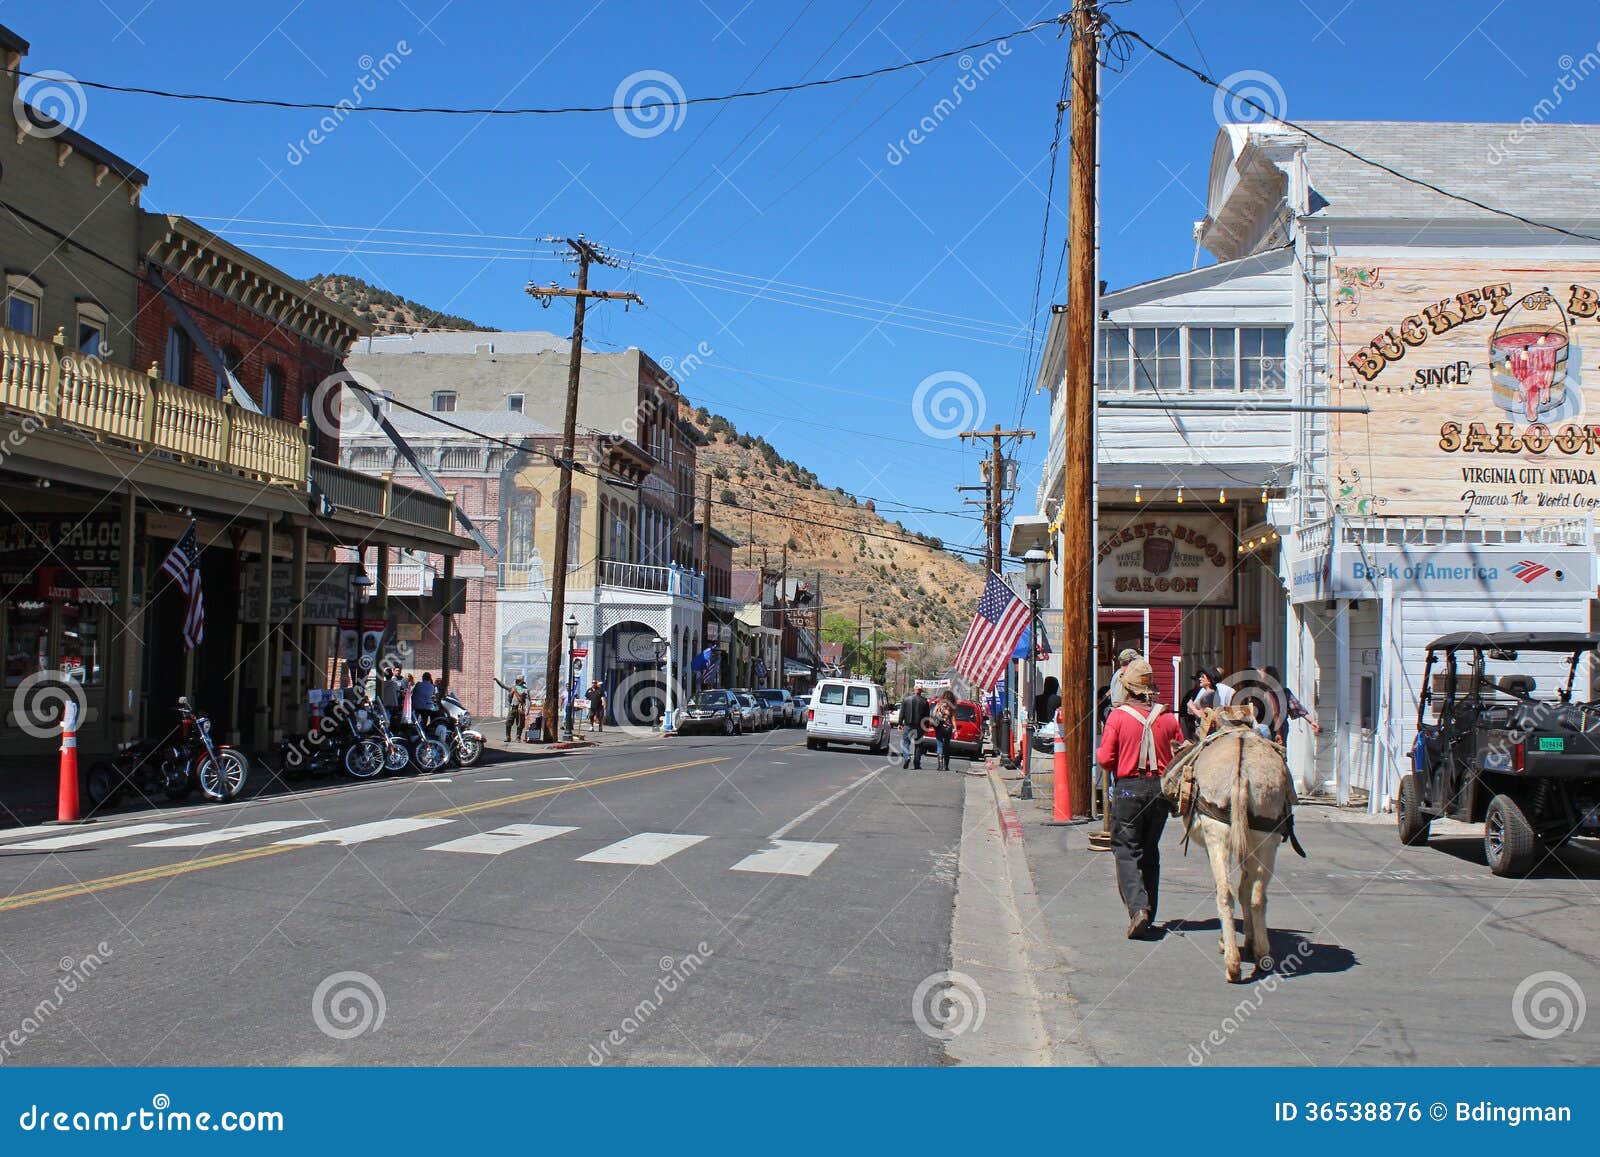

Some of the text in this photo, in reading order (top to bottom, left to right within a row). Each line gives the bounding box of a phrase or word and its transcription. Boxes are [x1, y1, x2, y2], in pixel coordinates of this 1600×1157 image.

[1348, 283, 1600, 381] BUCKET OF B
[1461, 467, 1597, 485] VIRGINIA CITY NEVADA
[1460, 489, 1509, 514] Famous
[1512, 490, 1528, 506] The
[1537, 492, 1570, 507] World
[59, 521, 120, 547] SALOO
[1353, 562, 1498, 580] Bank of America
[1115, 576, 1200, 593] SALOON
